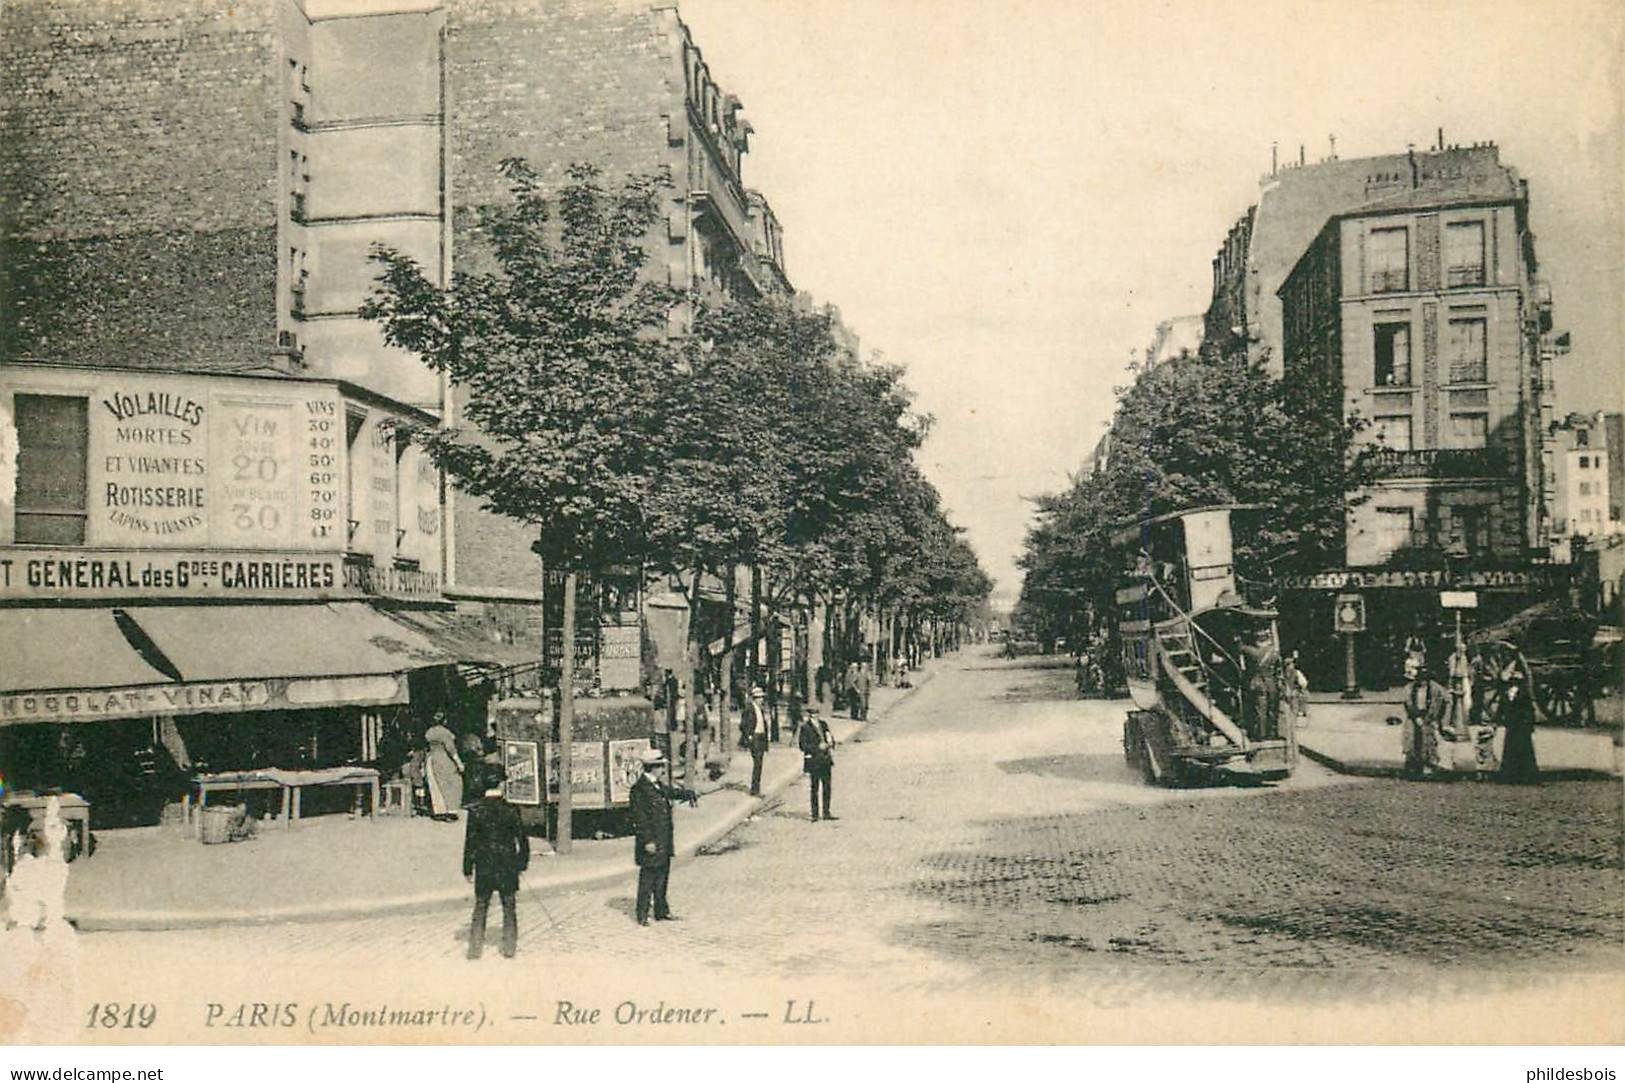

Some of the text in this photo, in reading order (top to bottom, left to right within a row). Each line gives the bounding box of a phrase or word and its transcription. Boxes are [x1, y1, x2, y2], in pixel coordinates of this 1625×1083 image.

[103, 391, 205, 426] VOLAILLES
[306, 400, 336, 415] VINS
[116, 427, 193, 446] MORTES
[232, 413, 277, 437] VIN
[105, 456, 205, 475] ET VIVANTES
[106, 482, 205, 508] ROTISSERIE
[109, 509, 202, 536] LAPINS VIVANTS
[28, 555, 140, 588] GÉNÉRAL
[142, 561, 174, 588] des
[221, 558, 335, 588] CARRIÈRES
